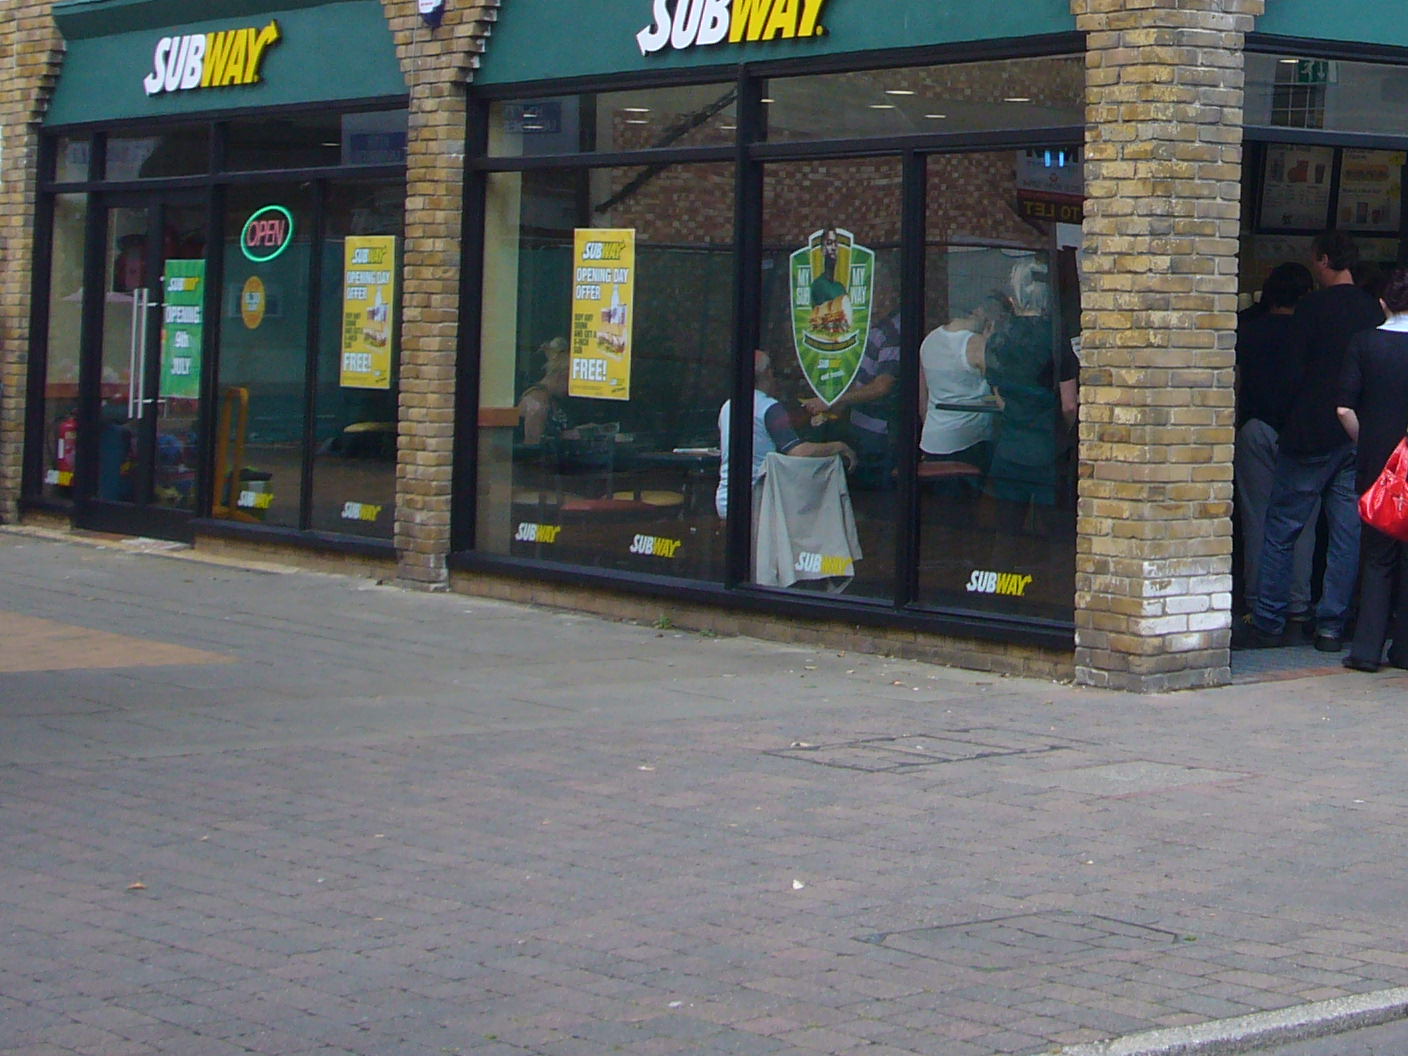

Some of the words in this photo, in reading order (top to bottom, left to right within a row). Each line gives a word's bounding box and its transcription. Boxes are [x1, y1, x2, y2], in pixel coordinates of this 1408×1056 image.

[144, 19, 280, 95] SUBWAY
[246, 219, 285, 247] OPEN
[351, 246, 387, 264] SUBWAY
[582, 241, 626, 260] SUBWAY
[575, 267, 612, 283] OPENING
[613, 268, 629, 283] DAY
[797, 268, 810, 286] MY
[852, 267, 865, 286] MY
[575, 284, 600, 300] OFFER
[796, 287, 811, 305] SUB
[850, 286, 866, 305] WAY
[165, 306, 201, 324] OPENING
[171, 357, 191, 375] JULY
[344, 352, 372, 372] FREE!
[572, 358, 607, 381] FREE!
[341, 501, 382, 521] SUBWAY
[515, 522, 560, 543] SUBWAY
[630, 534, 681, 558] SUBWAY
[795, 552, 854, 576] SUBWAY
[966, 570, 1033, 596] SUBWAY
